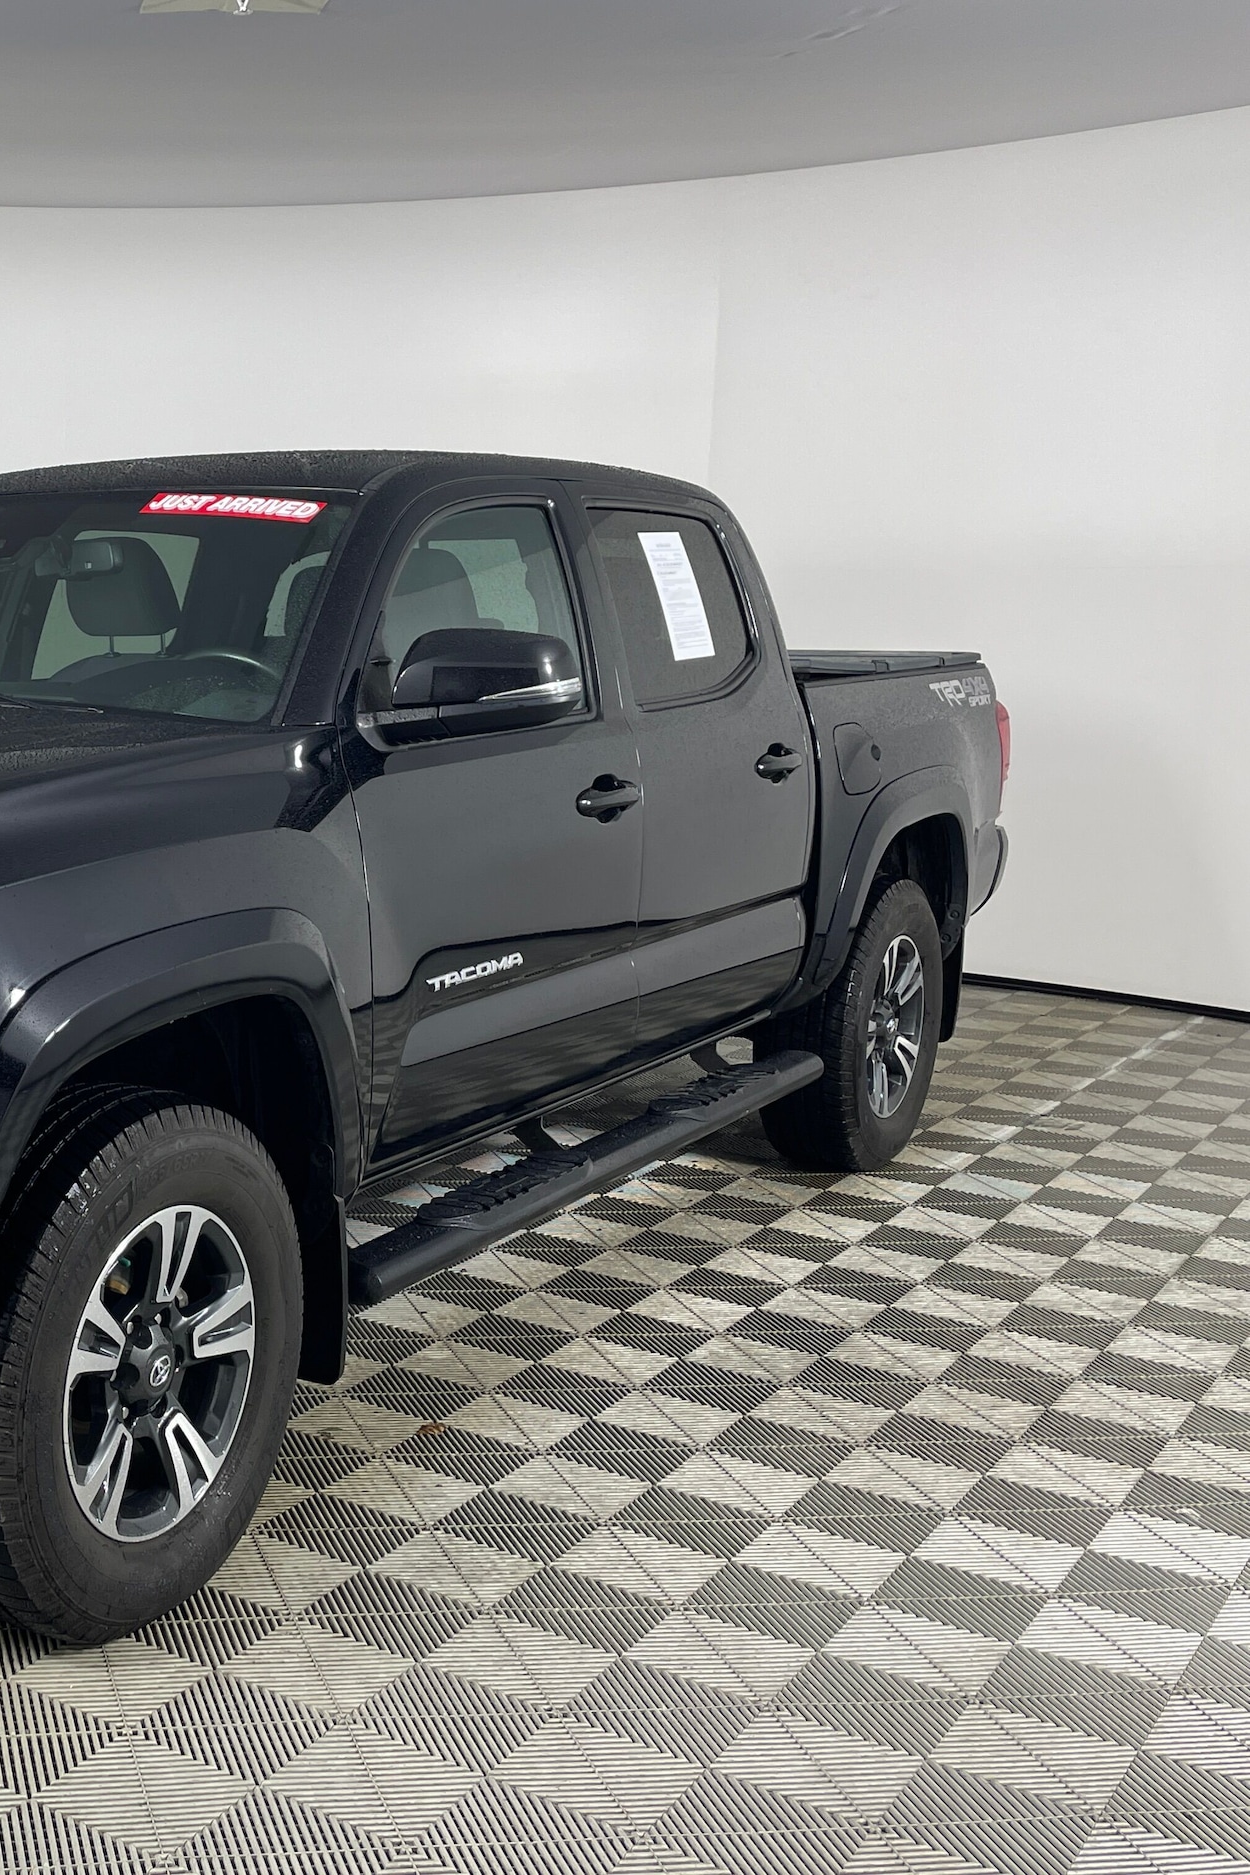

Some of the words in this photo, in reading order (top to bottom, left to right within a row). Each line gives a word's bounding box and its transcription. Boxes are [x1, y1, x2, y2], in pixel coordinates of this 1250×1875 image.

[149, 494, 216, 511] JUST
[207, 496, 321, 519] ARRIVED
[929, 679, 966, 707] TRD
[969, 694, 991, 708] SPORT
[426, 951, 524, 993] TACOMA
